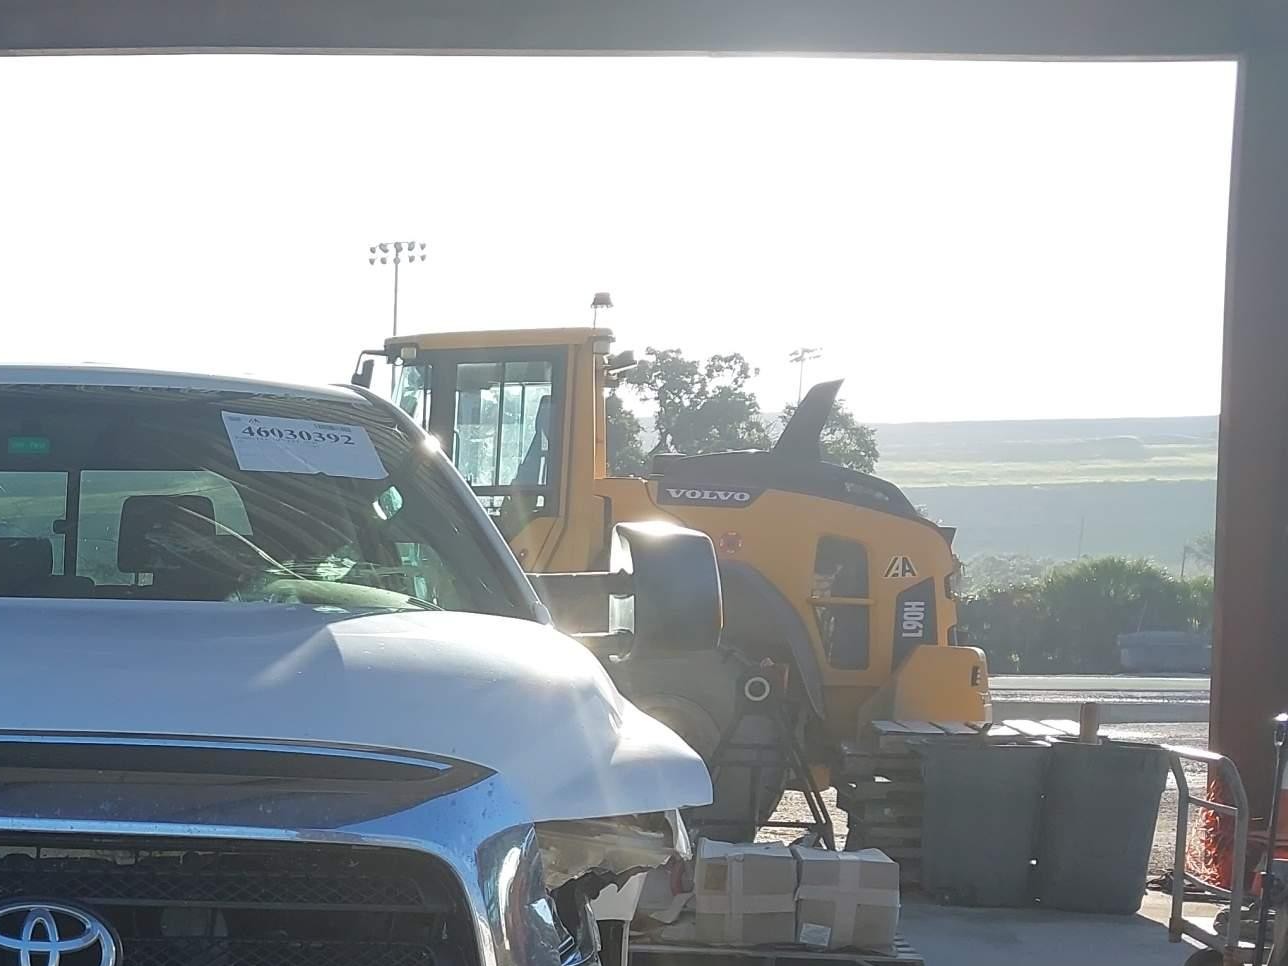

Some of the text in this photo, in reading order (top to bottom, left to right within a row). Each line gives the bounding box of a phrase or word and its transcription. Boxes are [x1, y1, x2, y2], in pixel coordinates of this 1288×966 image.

[242, 425, 355, 445] 46030392
[666, 488, 750, 501] VOLVO
[902, 601, 925, 638] L90H
